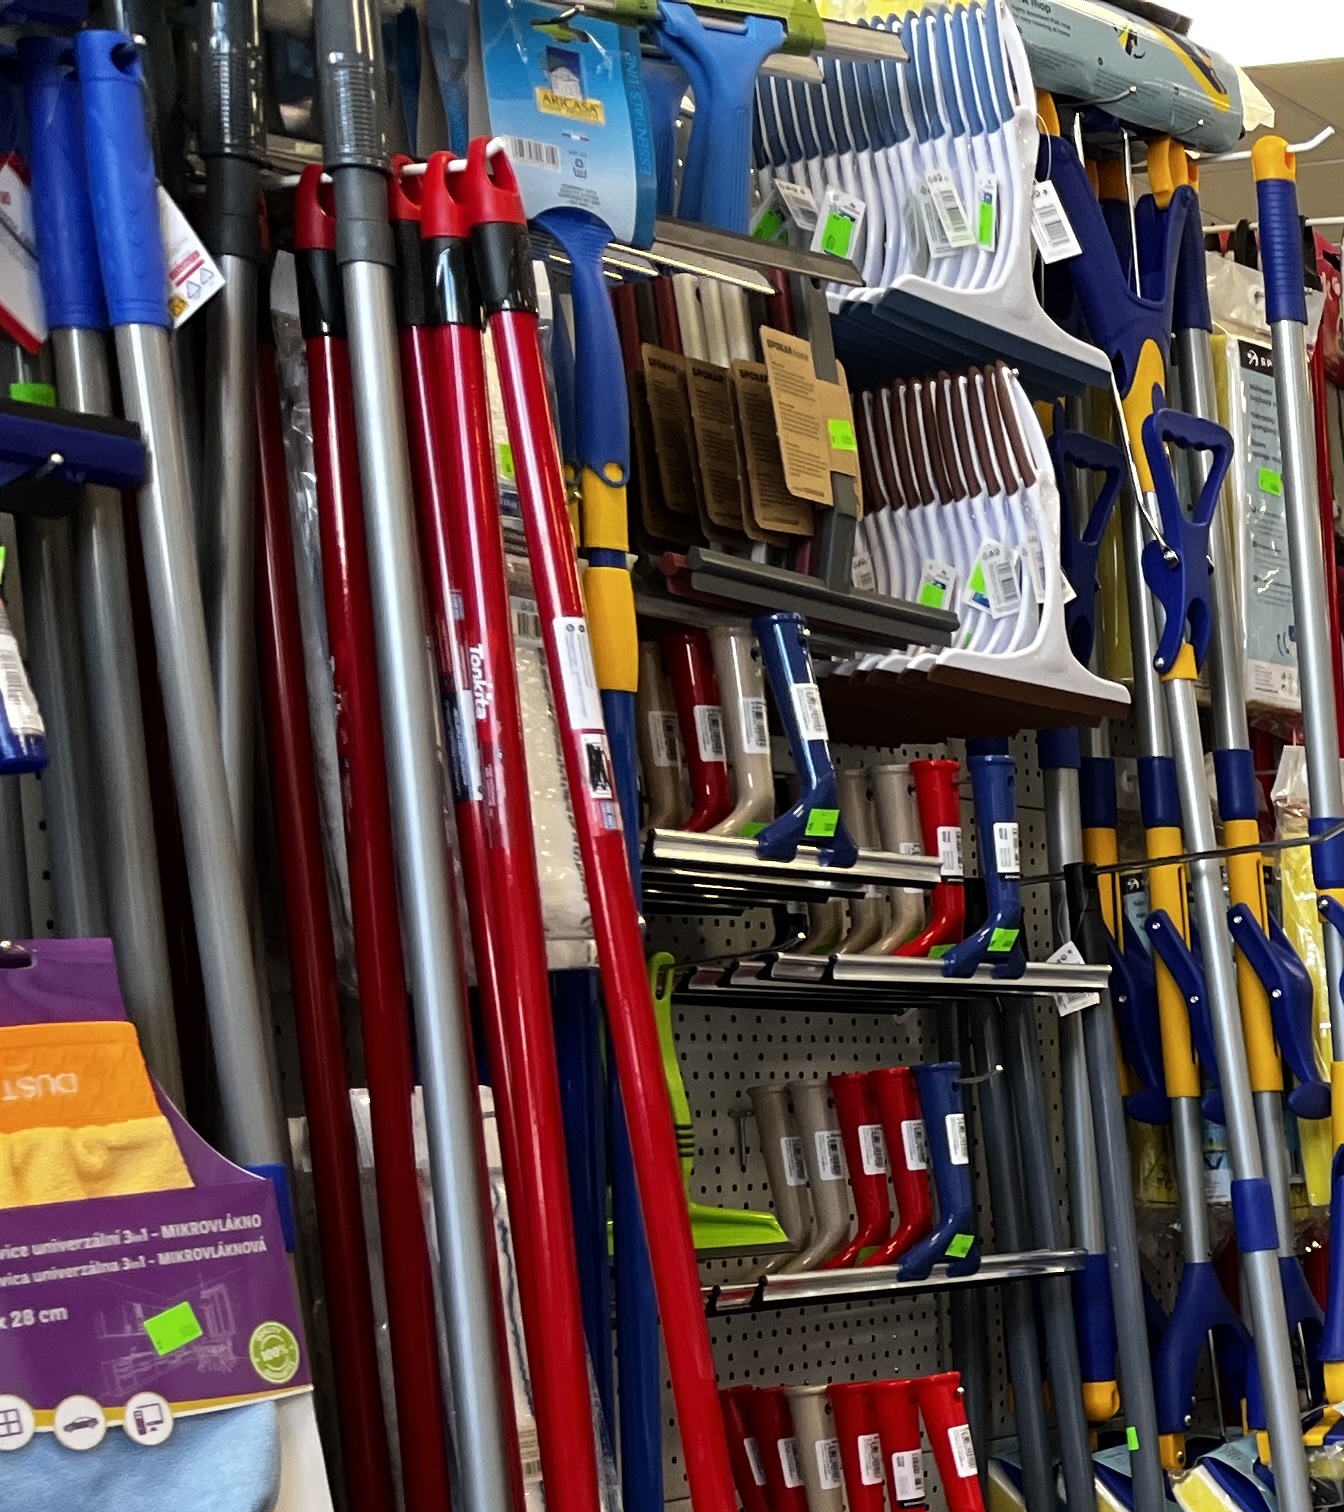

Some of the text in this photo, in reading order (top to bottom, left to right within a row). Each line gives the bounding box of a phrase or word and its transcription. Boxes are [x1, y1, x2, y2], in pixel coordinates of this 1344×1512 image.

[160, 1212, 263, 1240] MIKROVLÁKNO
[157, 1234, 268, 1266] MIKROVLÁKNOVÁ
[9, 1308, 36, 1329] 28
[38, 1305, 69, 1324] cm
